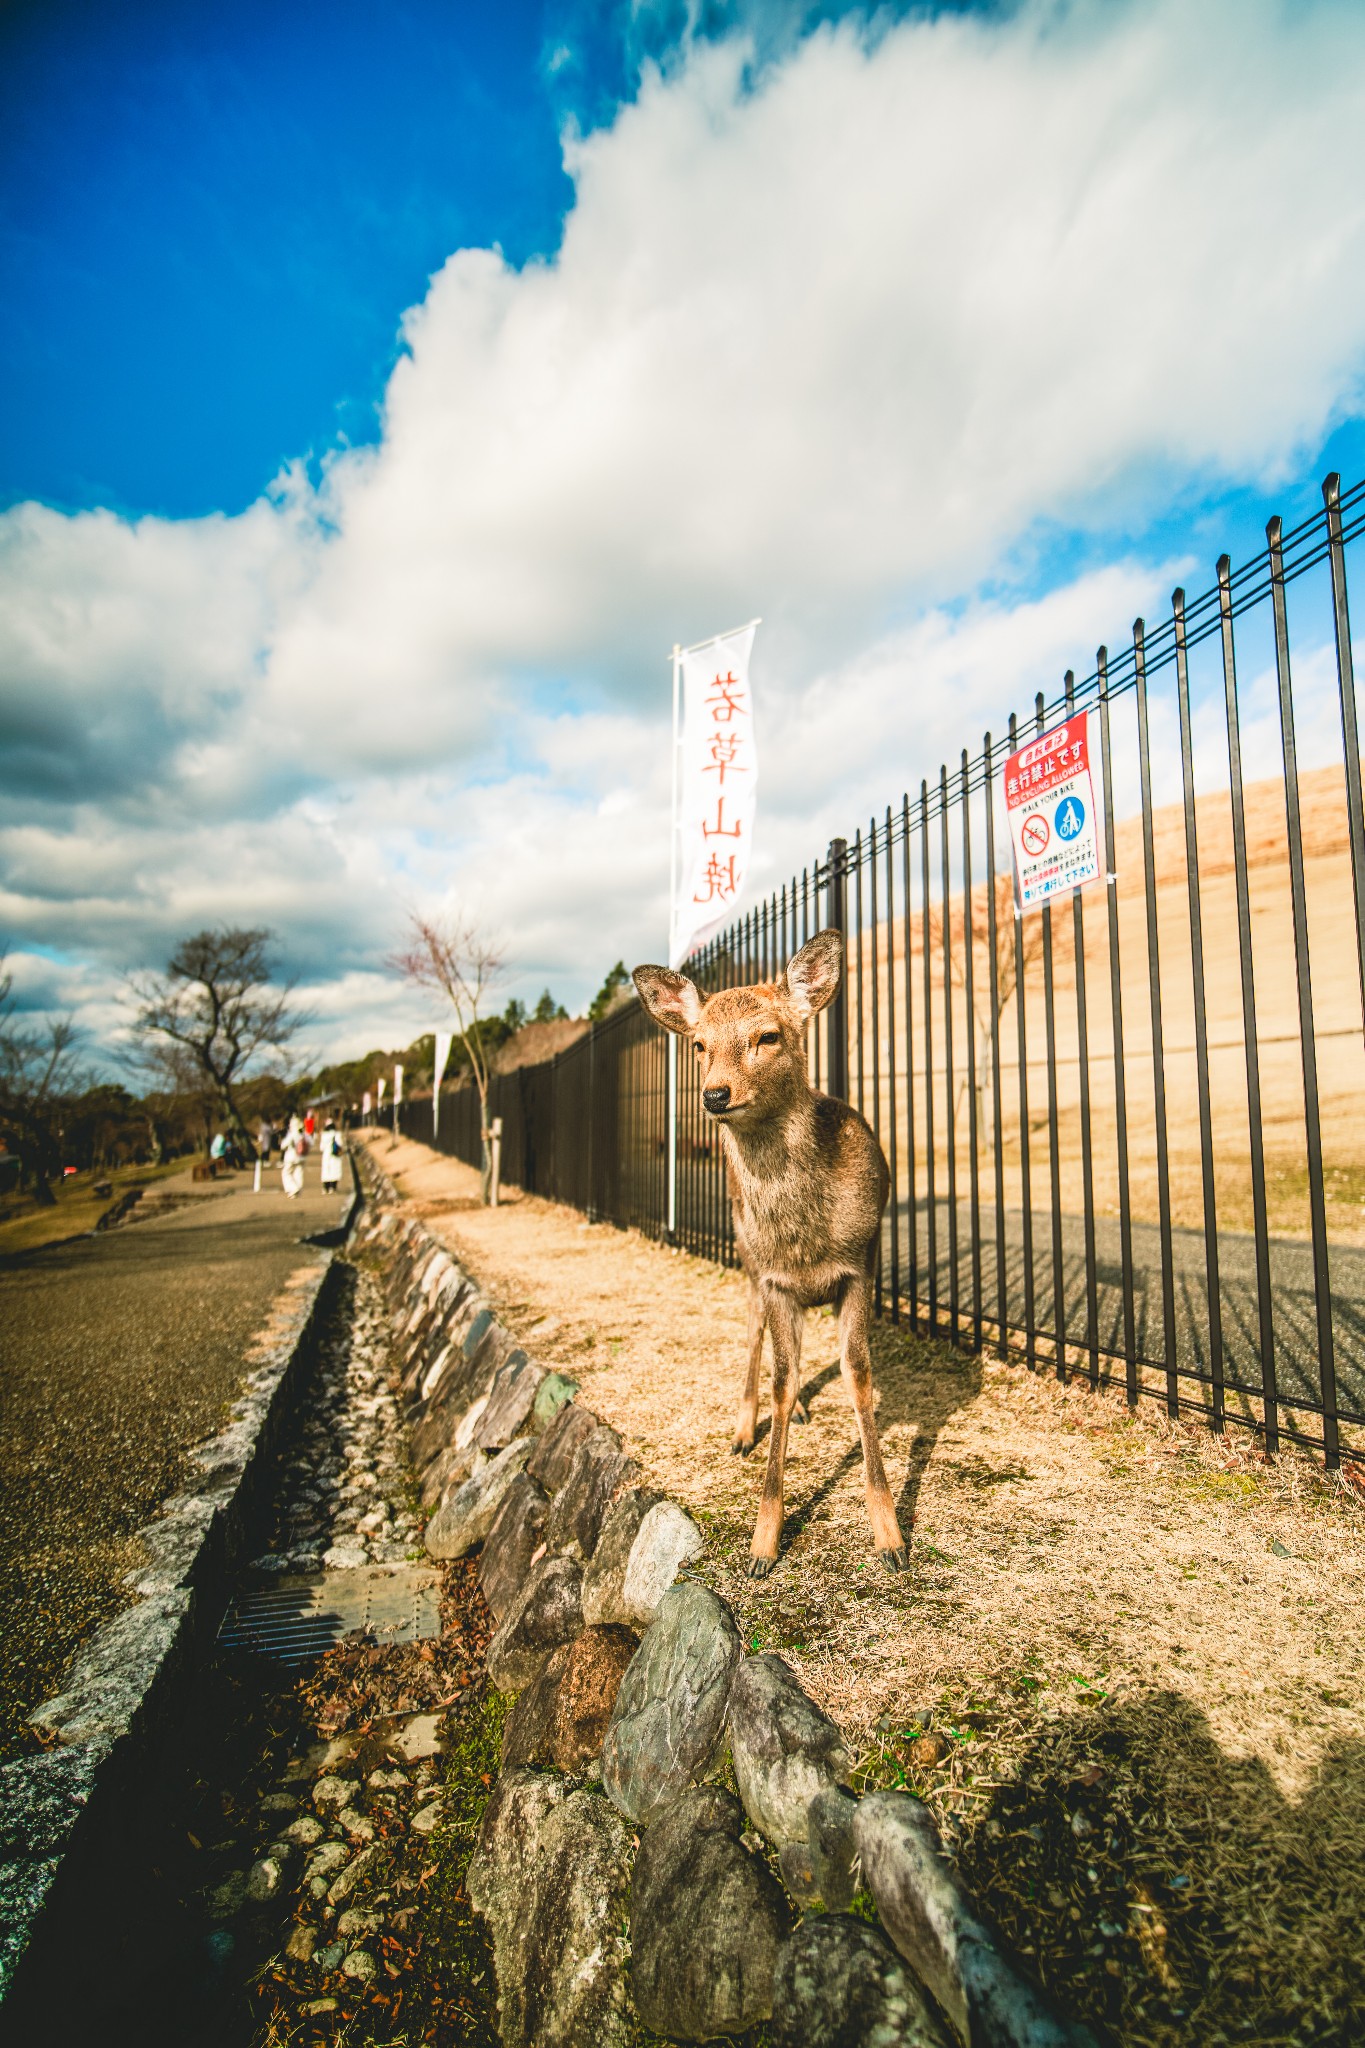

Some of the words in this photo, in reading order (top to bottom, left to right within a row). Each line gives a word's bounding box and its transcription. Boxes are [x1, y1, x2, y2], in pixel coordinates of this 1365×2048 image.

[1007, 740, 1084, 796] 走行禁止です
[1009, 796, 1020, 807] NO
[1019, 780, 1050, 799] CYCLING
[1052, 760, 1084, 784] ALLOWED
[1022, 802, 1039, 814] WALK
[1040, 790, 1058, 803] YOUR
[1060, 782, 1075, 794] BIKE
